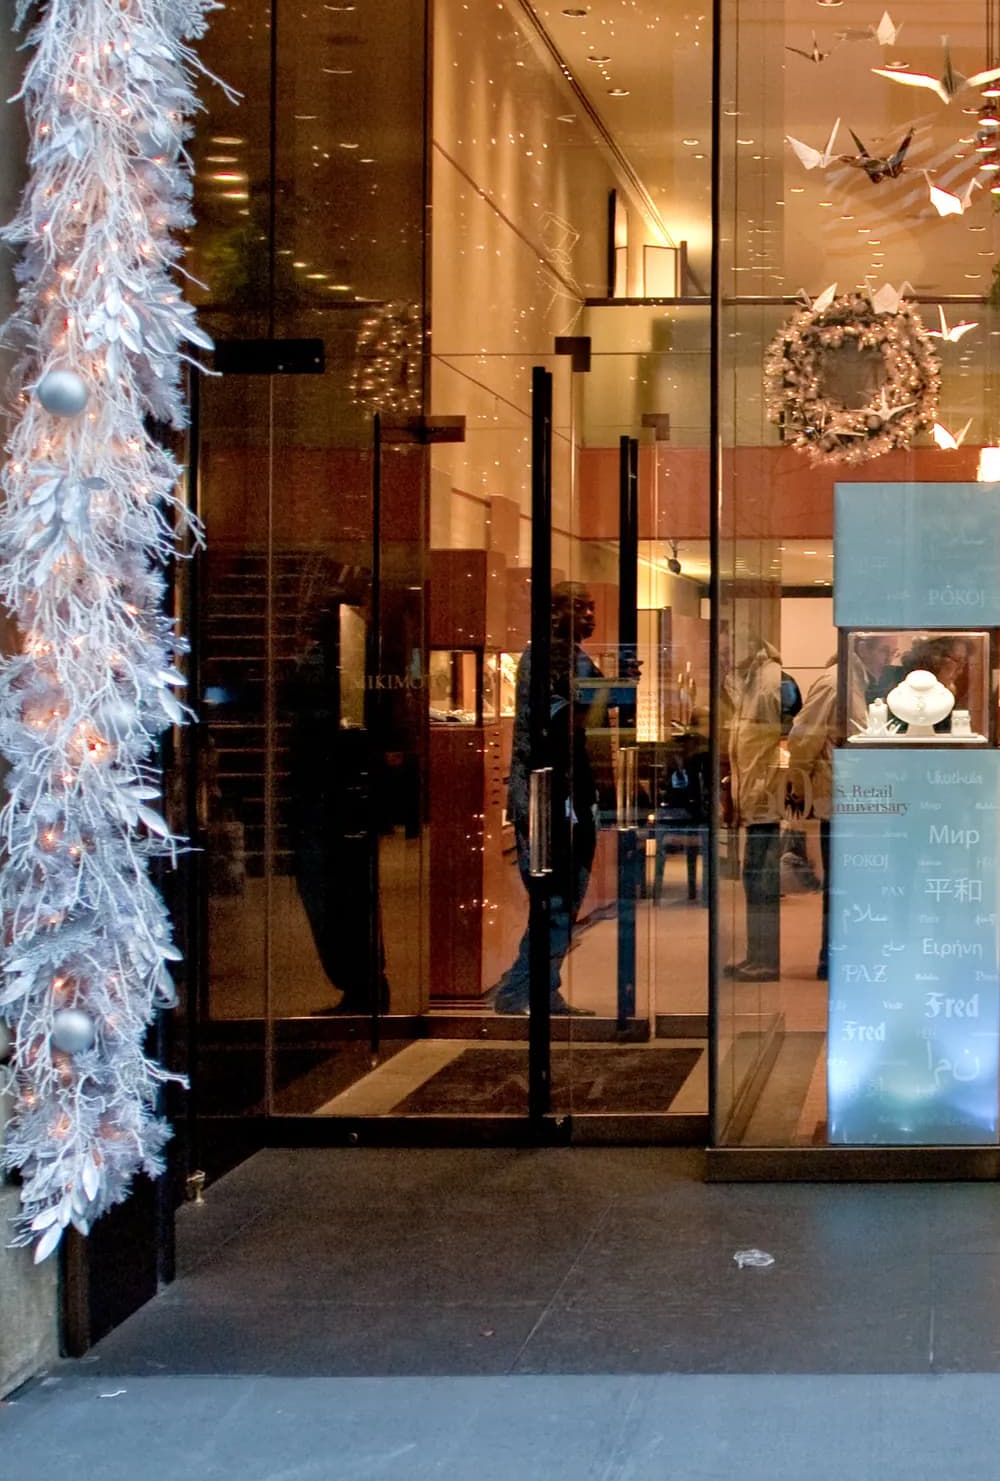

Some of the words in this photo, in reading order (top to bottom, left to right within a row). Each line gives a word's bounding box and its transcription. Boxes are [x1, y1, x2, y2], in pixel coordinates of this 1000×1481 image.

[852, 786, 893, 799] Retail
[928, 824, 981, 849] Мир
[924, 877, 982, 903] 平和
[922, 938, 984, 959] Ειρήνη
[924, 992, 979, 1018] Fred
[843, 1021, 886, 1041] Fred
